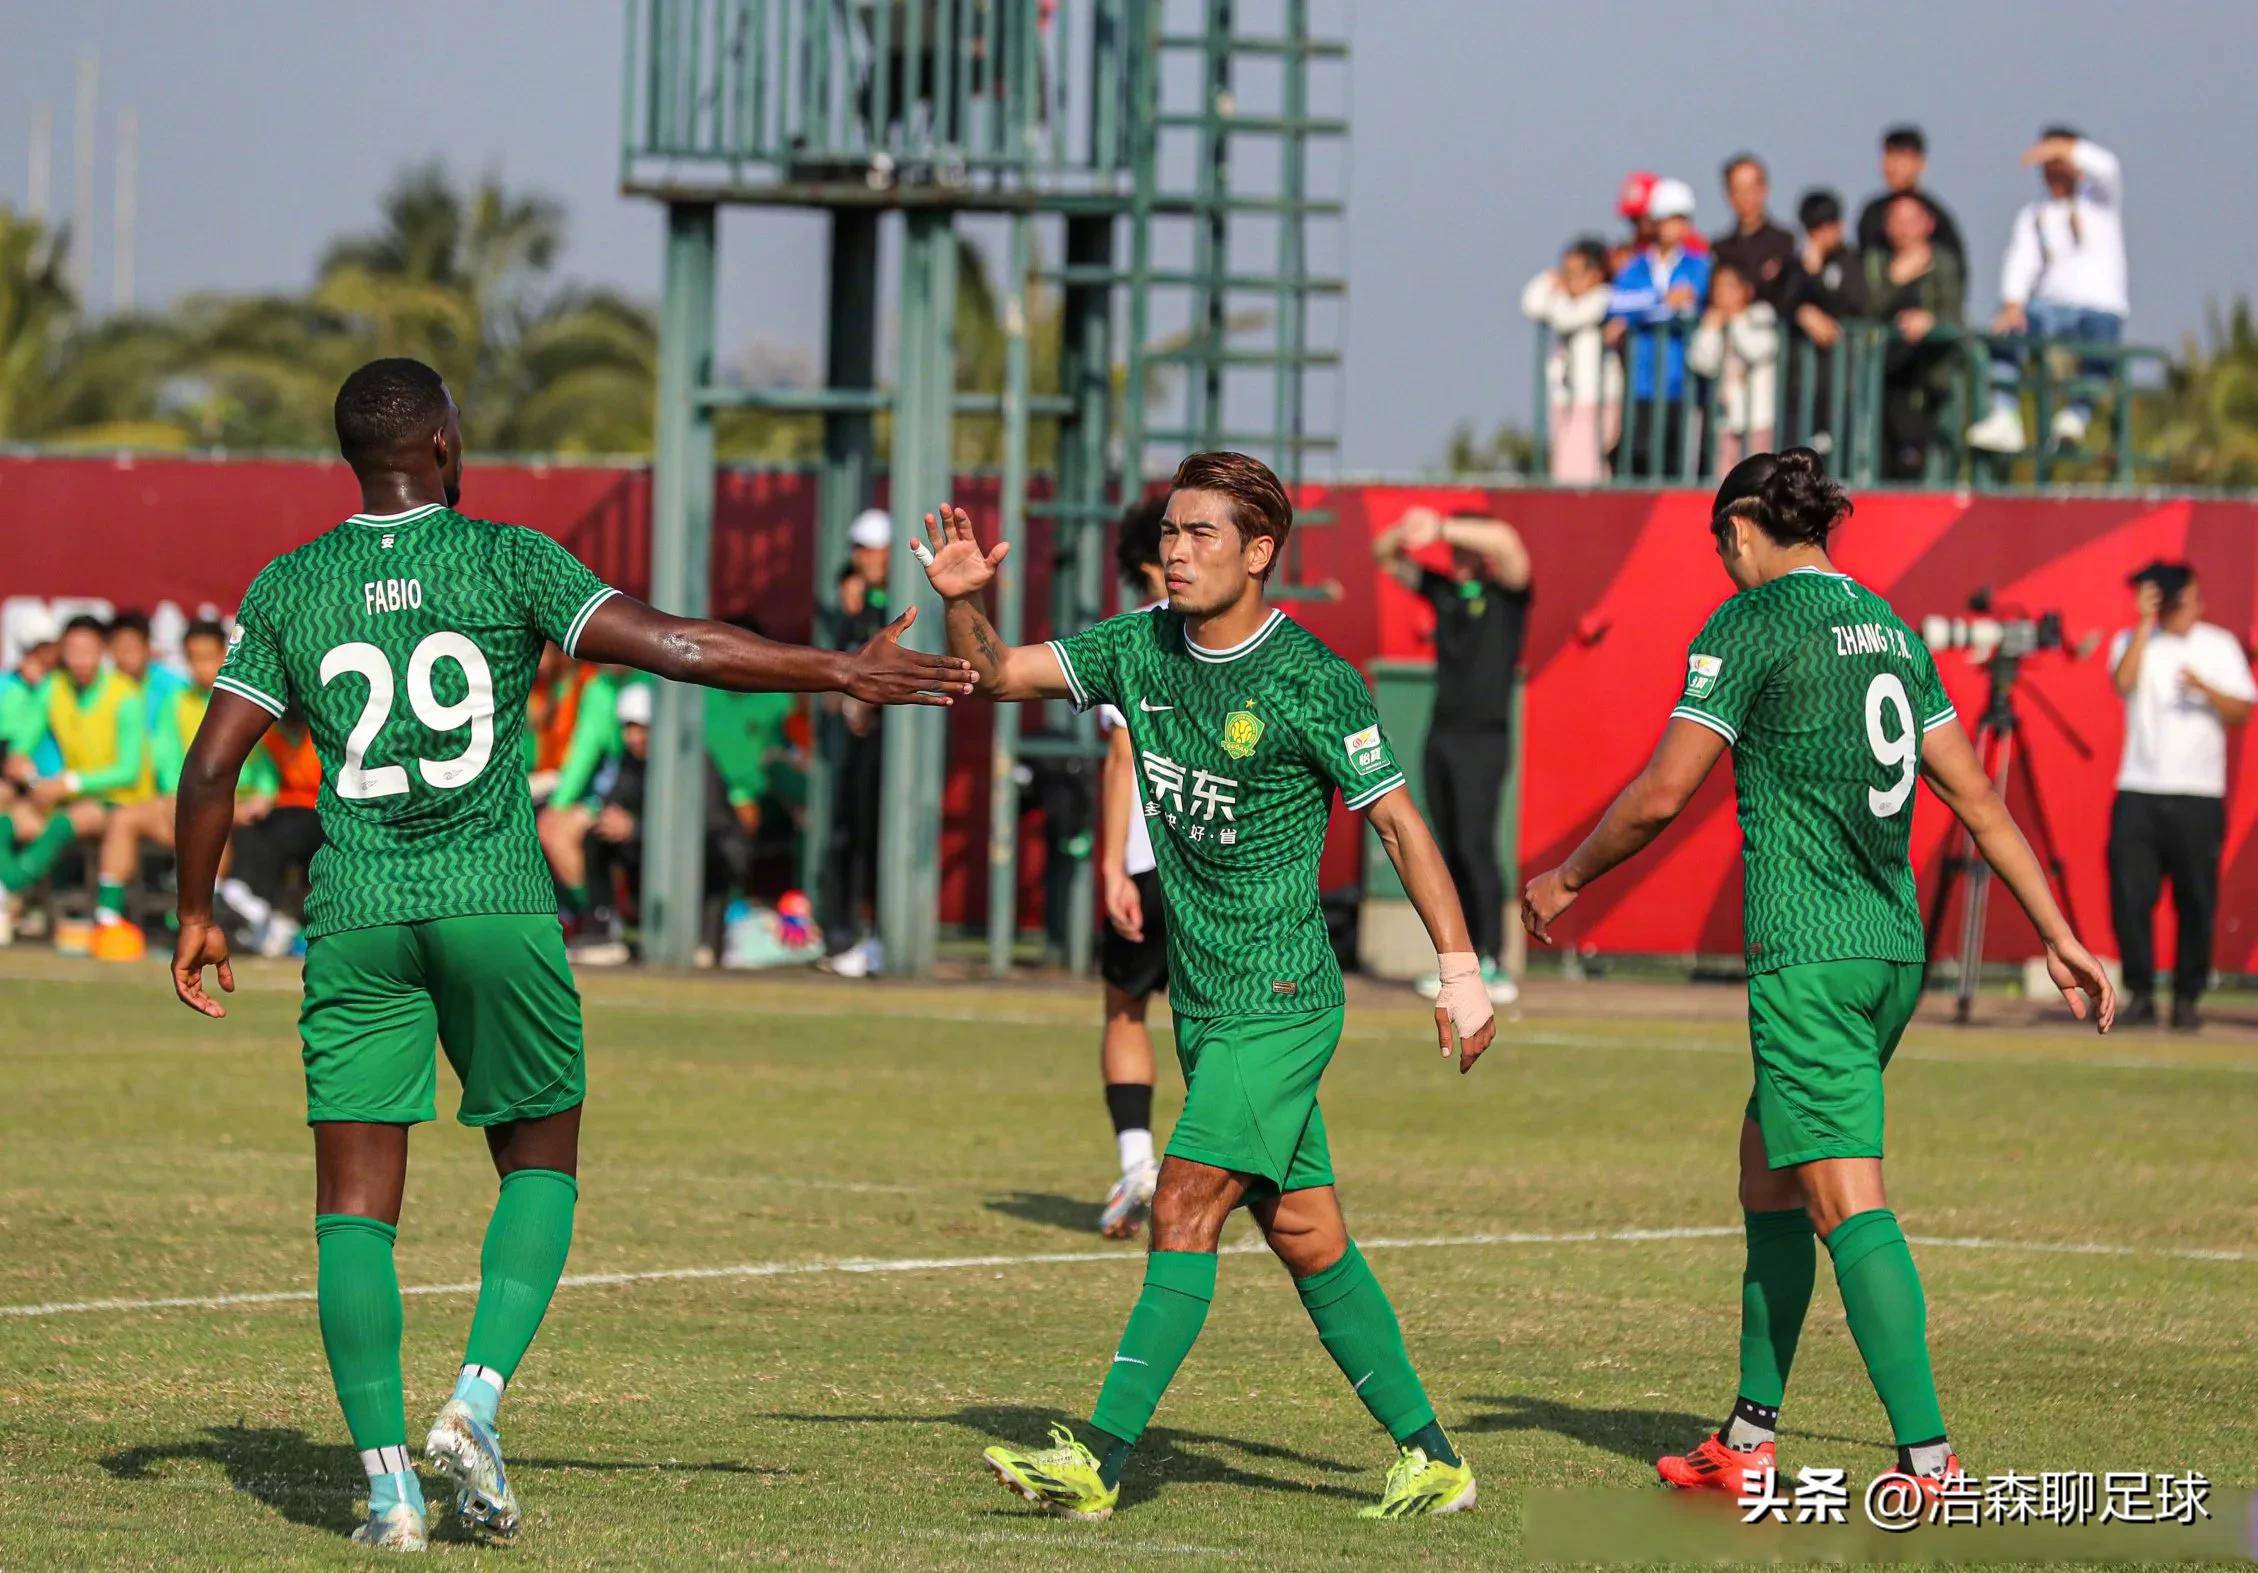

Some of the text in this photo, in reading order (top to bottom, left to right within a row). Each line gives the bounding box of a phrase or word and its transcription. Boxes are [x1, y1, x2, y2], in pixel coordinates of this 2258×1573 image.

[364, 578, 422, 615] FABIO
[1831, 622, 1888, 656] ZHANG
[319, 631, 495, 799] 29
[1865, 672, 1916, 818] 9
[1142, 750, 1238, 822] 京东
